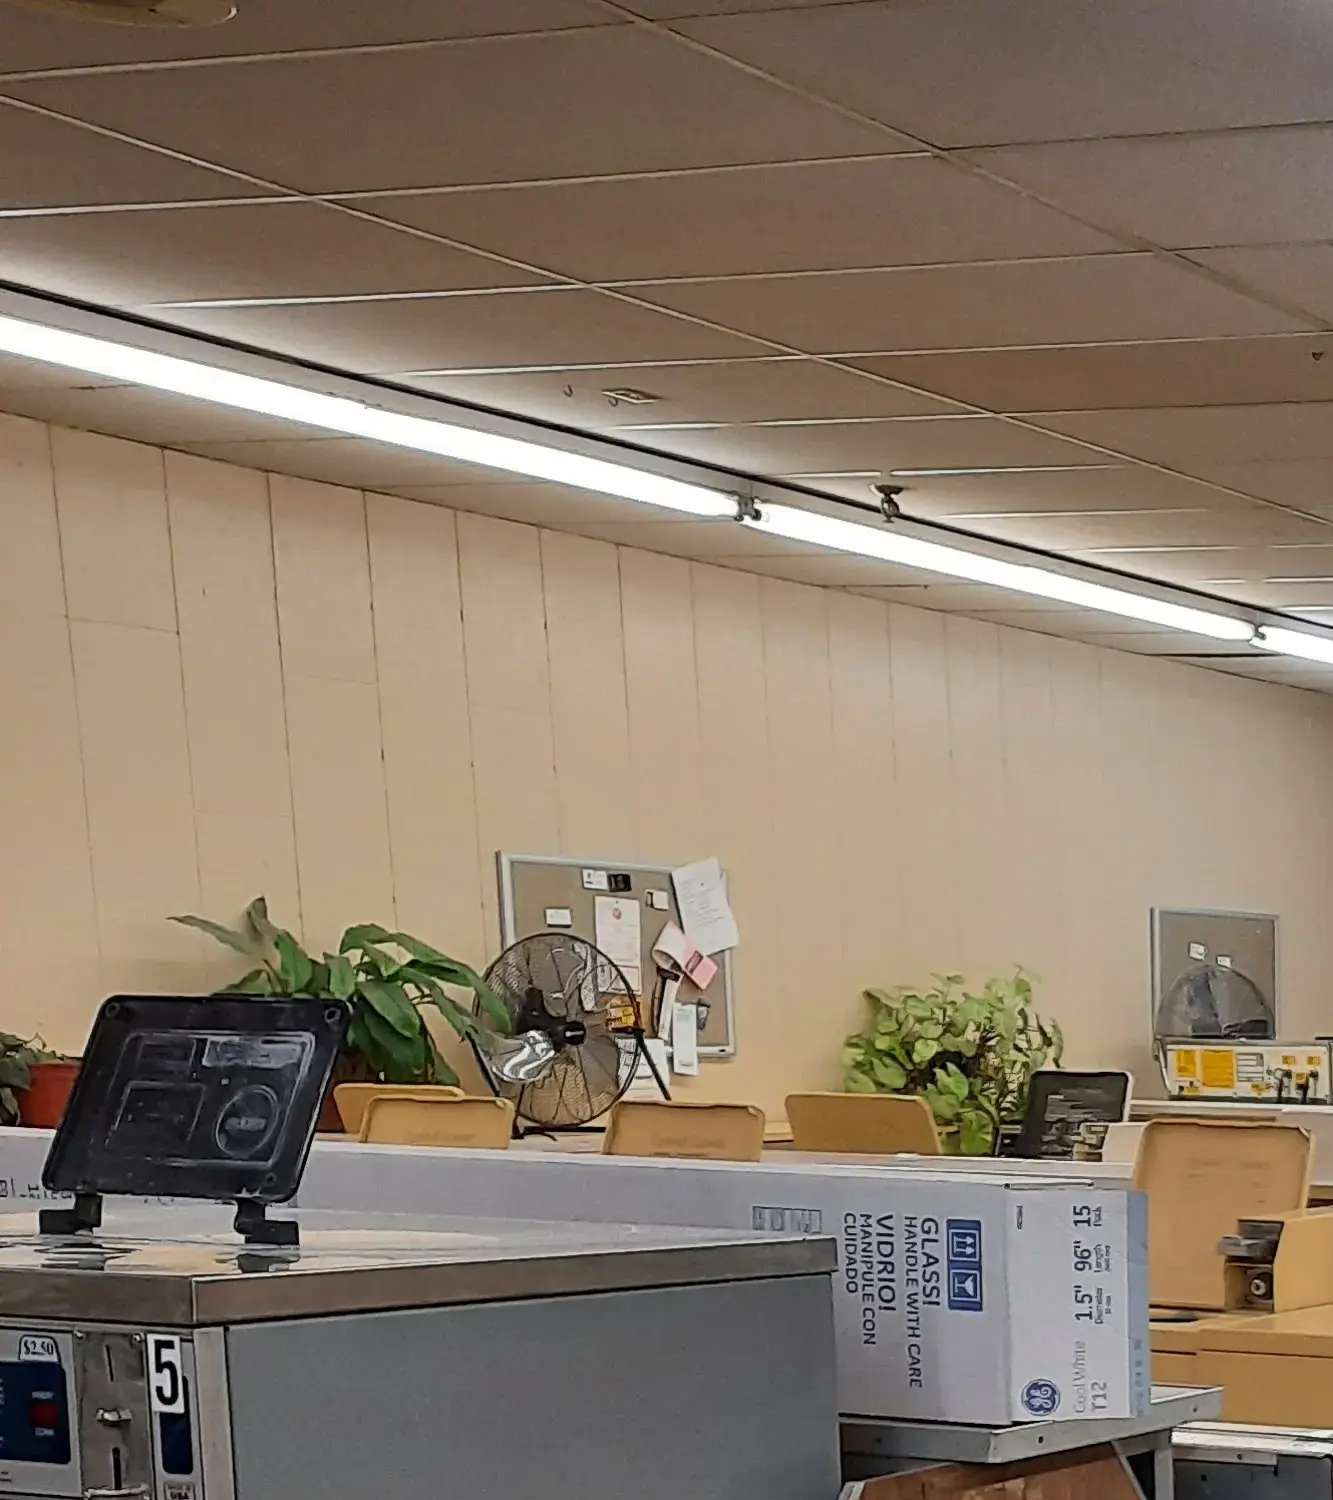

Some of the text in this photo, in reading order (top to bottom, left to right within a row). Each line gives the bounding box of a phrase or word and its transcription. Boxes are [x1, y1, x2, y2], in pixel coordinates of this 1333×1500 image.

[843, 1212, 859, 1294] CUIDADO
[1073, 1205, 1092, 1228] 15
[859, 1213, 876, 1346] MANIPULE CON
[876, 1213, 897, 1312] VIDRIO!
[904, 1216, 922, 1389] HANDLE WITH CARE
[921, 1217, 941, 1307] GLASS!
[154, 1339, 180, 1406] 5
